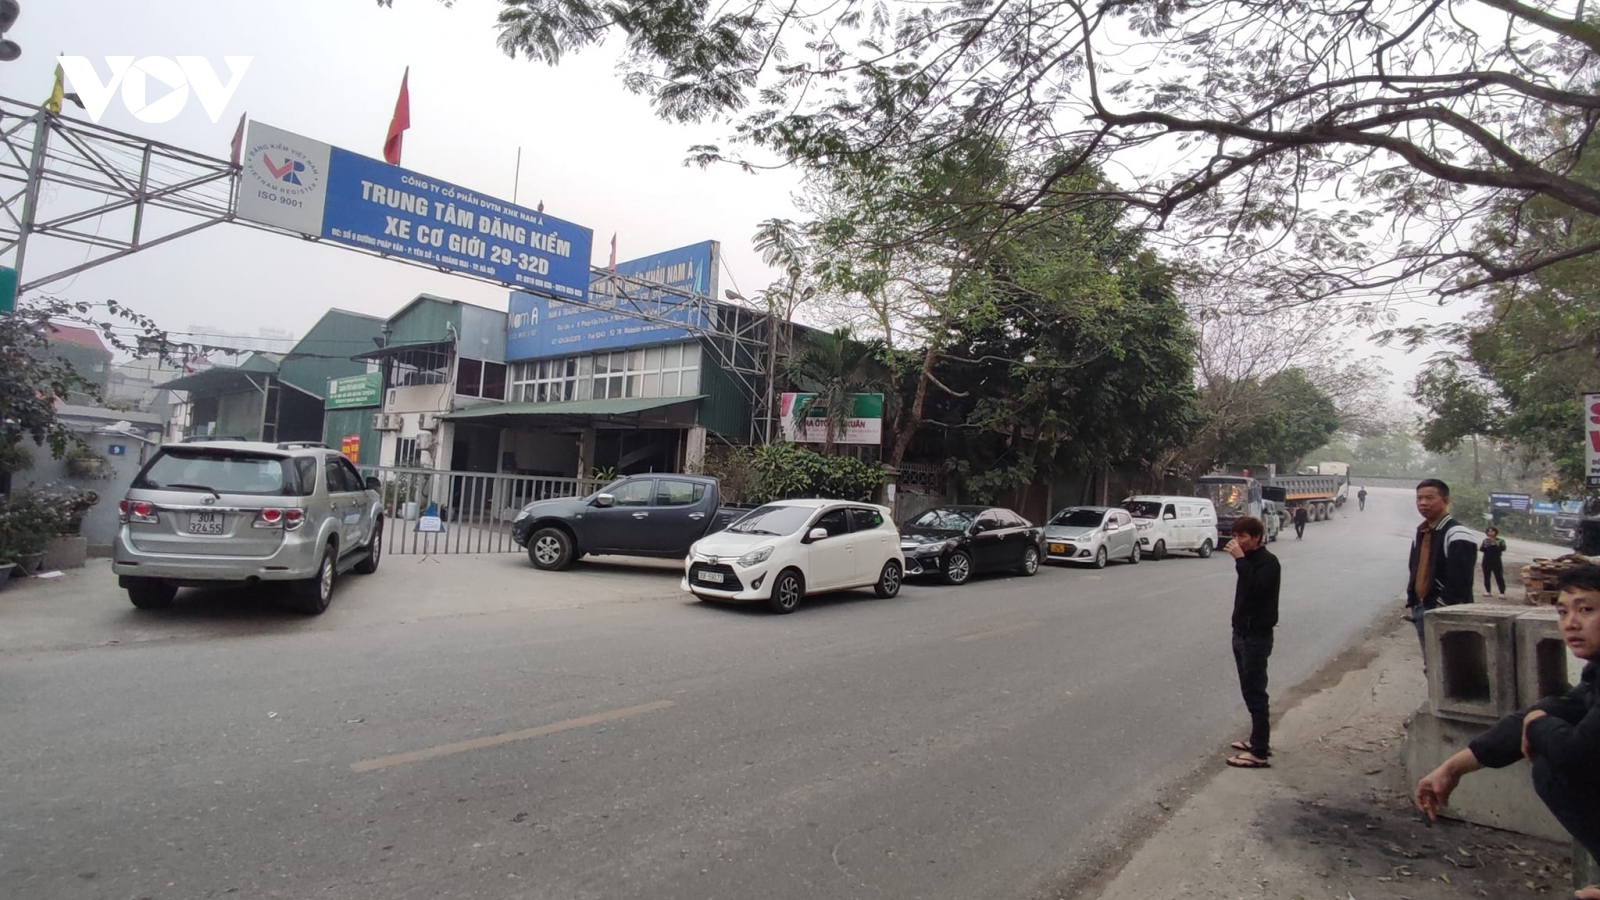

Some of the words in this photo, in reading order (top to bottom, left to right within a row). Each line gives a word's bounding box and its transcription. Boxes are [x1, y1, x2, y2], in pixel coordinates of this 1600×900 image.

[248, 164, 278, 191] VIETNAM
[280, 182, 317, 195] REGISTER
[258, 190, 277, 201] ISO
[279, 196, 303, 208] 9001
[401, 175, 428, 189] CÔNG
[430, 184, 439, 193] TY
[480, 201, 501, 213] DVTM
[502, 207, 519, 218] XNK
[520, 212, 537, 225] NAM
[361, 180, 429, 217] TRUNG
[434, 202, 474, 229] TÂM
[478, 216, 526, 245] ĐĂNG
[530, 231, 571, 258] KIỂM
[384, 215, 411, 239] XE
[417, 225, 444, 248] CƠ
[448, 233, 486, 259] GIỚI
[490, 245, 549, 275] 29-32D
[667, 262, 685, 284] NAM
[198, 513, 215, 522] 30A
